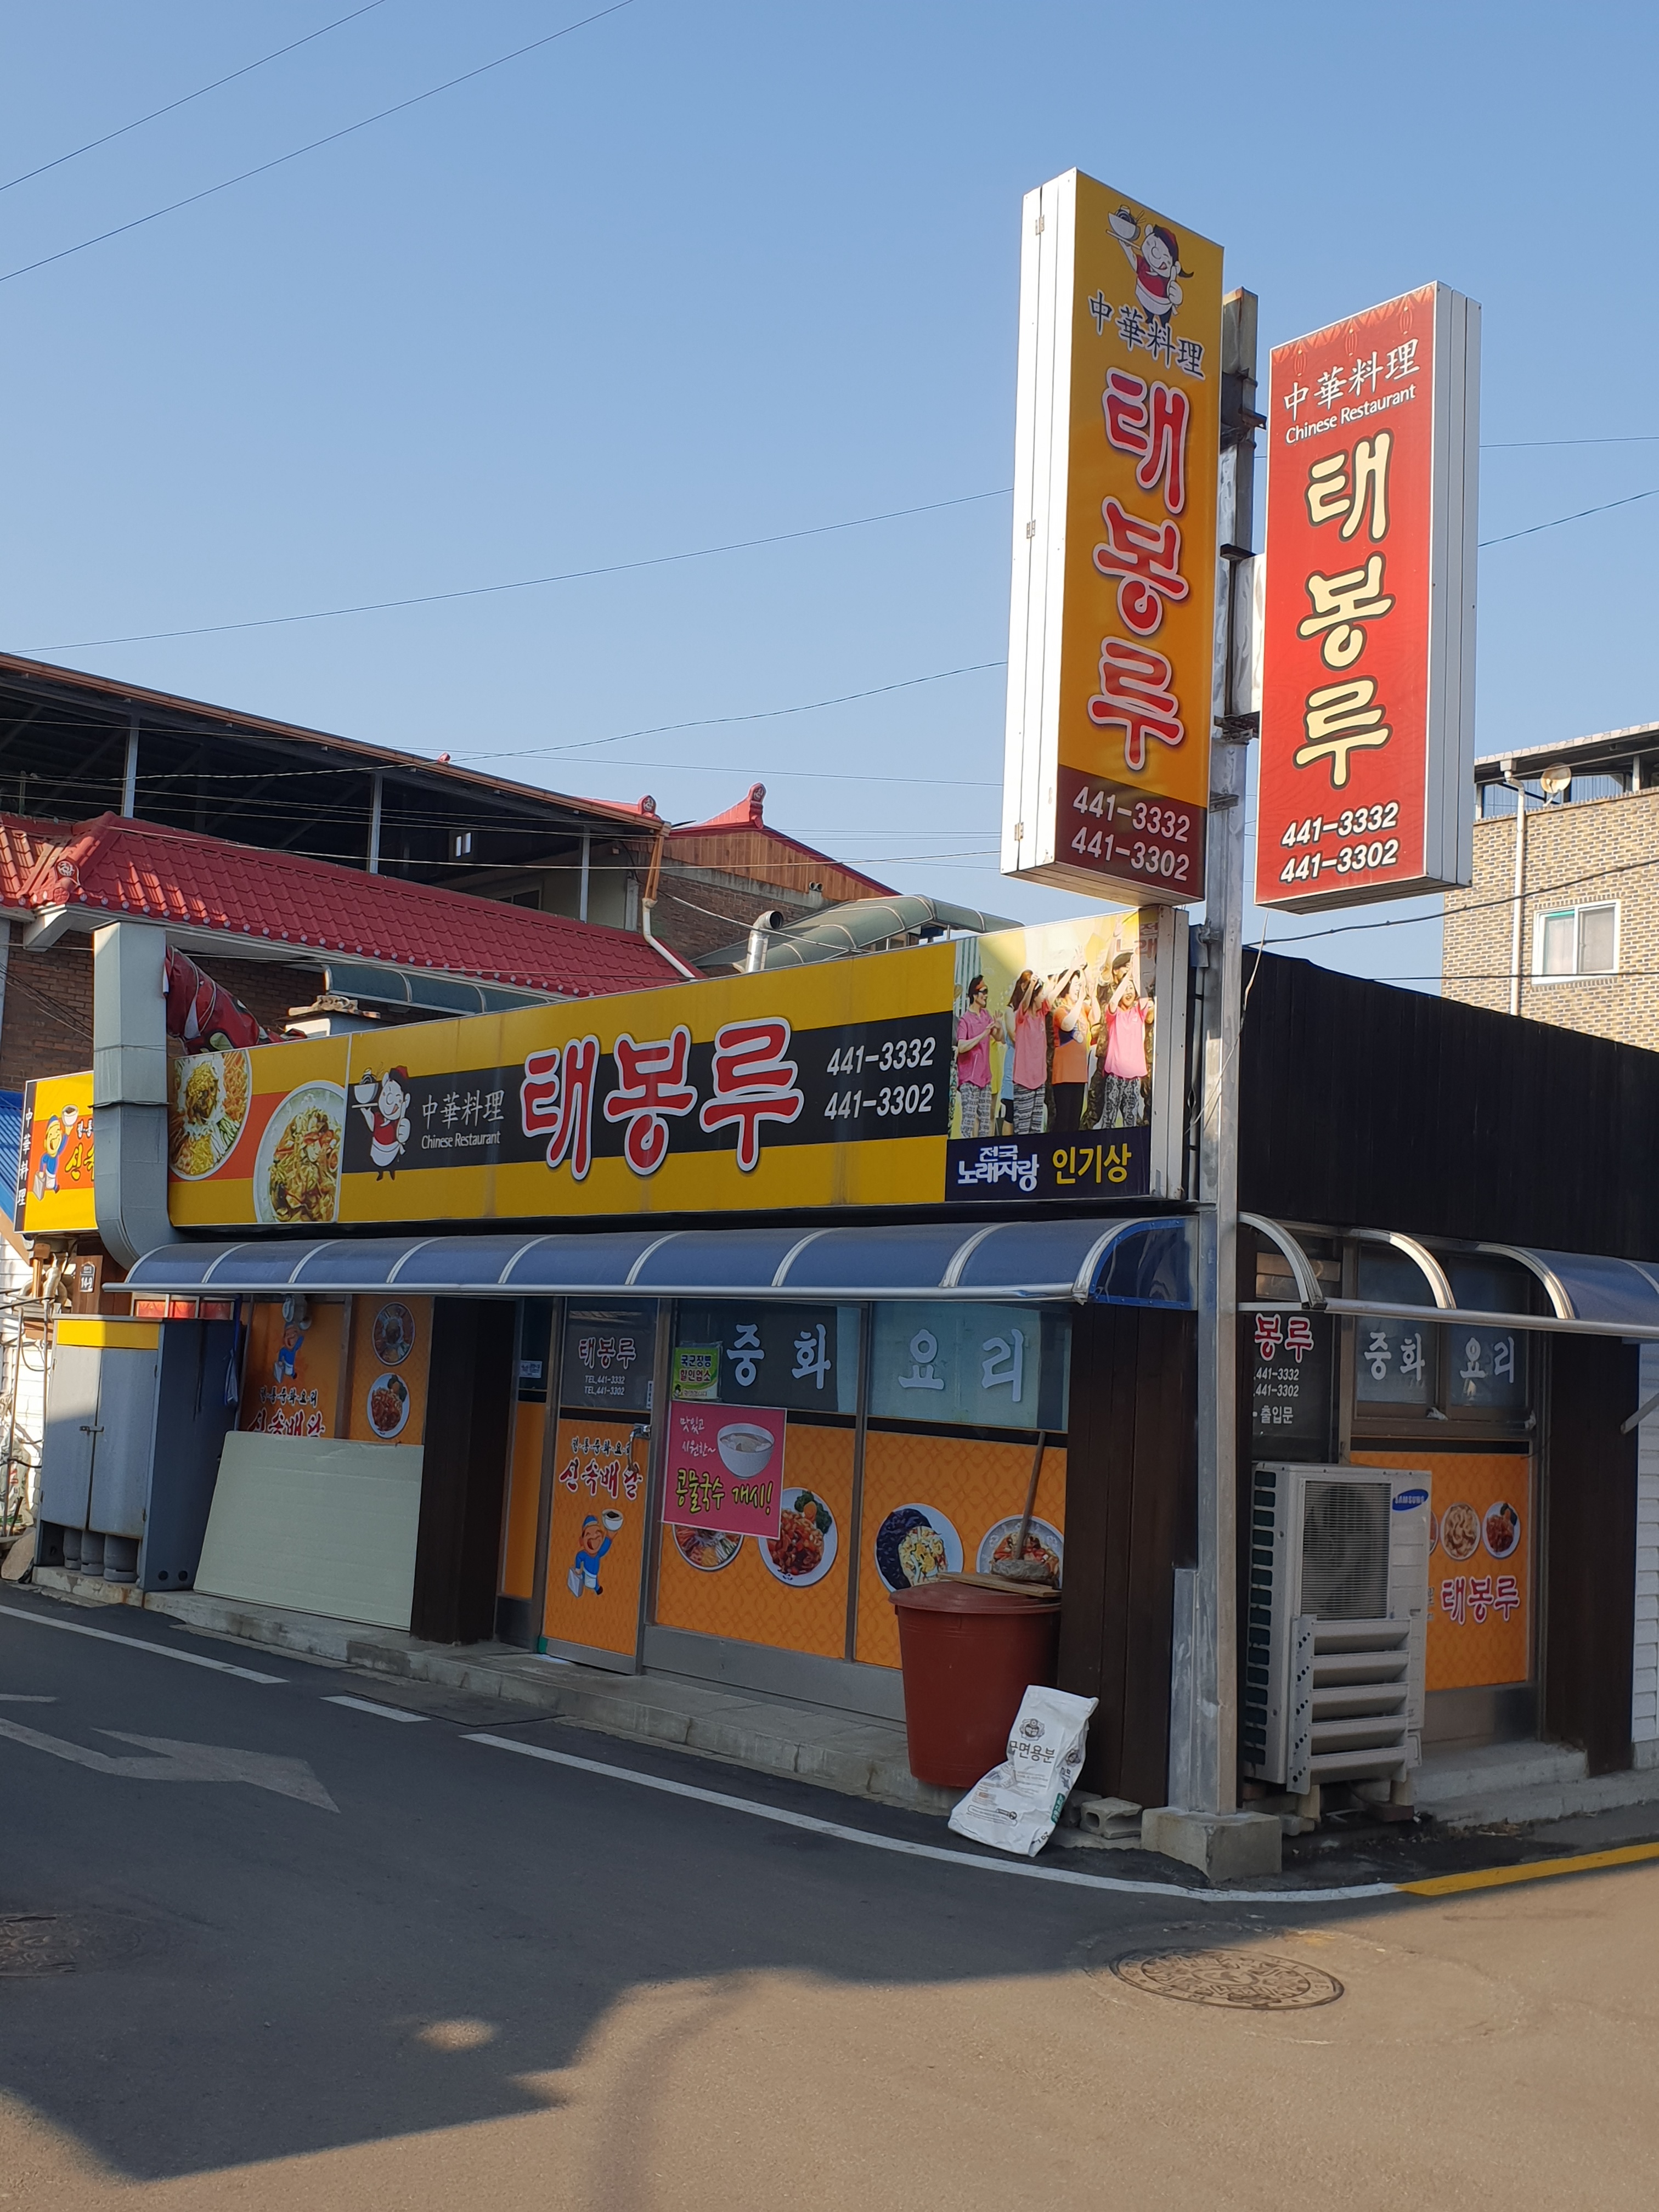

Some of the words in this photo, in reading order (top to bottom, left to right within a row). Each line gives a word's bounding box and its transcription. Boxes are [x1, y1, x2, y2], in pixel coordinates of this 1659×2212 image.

[1088, 289, 1206, 380] 中華料理
[1283, 337, 1420, 422] 中華料理
[1285, 414, 1338, 444] Chinese
[1341, 383, 1417, 424] Restaurant
[1088, 367, 1190, 770] 태봉루
[1294, 428, 1395, 789] 태봉루
[1073, 786, 1190, 843] 441-3332
[1281, 802, 1400, 848] 441-3332
[1071, 826, 1190, 882] 441-3302
[1280, 839, 1399, 884] 441-3302
[826, 1037, 935, 1076] 441-3332
[422, 1090, 505, 1130] 中華料理
[520, 1017, 804, 1180] 태봉루
[824, 1083, 934, 1120] 441-3302
[422, 1132, 453, 1149] Chinese
[455, 1131, 500, 1147] Restaurant
[980, 1145, 1018, 1162] 전국
[957, 1154, 1040, 1192] 노래자랑
[1053, 1143, 1132, 1184] 인기상
[81, 1277, 92, 1288] 14-9
[578, 1337, 636, 1369] 태봉루
[680, 1369, 711, 1382] 할인업소
[680, 1416, 704, 1435] 맛있고
[1261, 1405, 1294, 1424] 출입문
[559, 1457, 643, 1500] 신속배달
[675, 1468, 725, 1514] 콩물국수
[732, 1481, 773, 1515] 개시!
[1395, 1496, 1425, 1504] SAMSUNG
[1440, 1575, 1520, 1626] 태봉루
